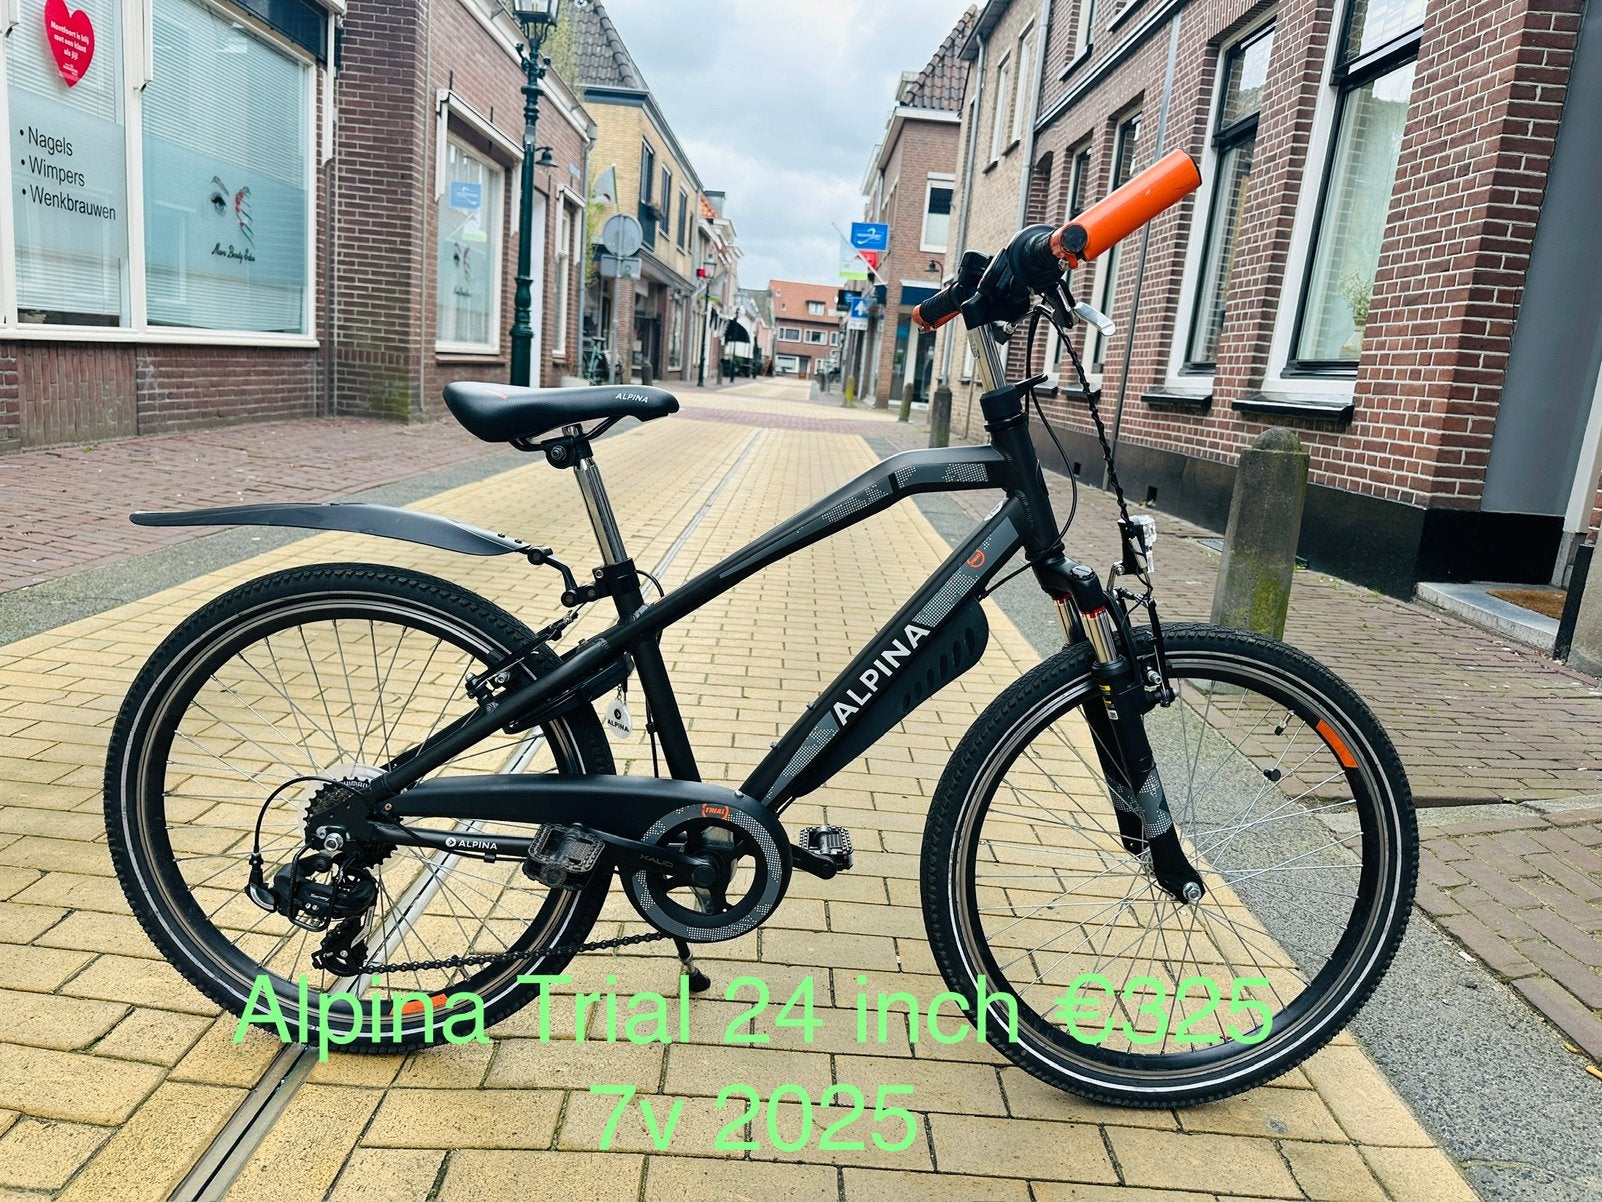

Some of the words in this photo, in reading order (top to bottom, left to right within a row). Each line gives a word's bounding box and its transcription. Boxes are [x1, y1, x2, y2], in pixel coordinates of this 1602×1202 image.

[28, 126, 73, 156] Nagels
[29, 155, 85, 187] Wimpers
[29, 184, 116, 220] Wenkbrauwen
[615, 392, 649, 403] ALPINA
[833, 624, 931, 726] ALPINA
[607, 719, 630, 732] ALPINA
[705, 806, 726, 815] TRIAL
[458, 839, 498, 850] ALPINA
